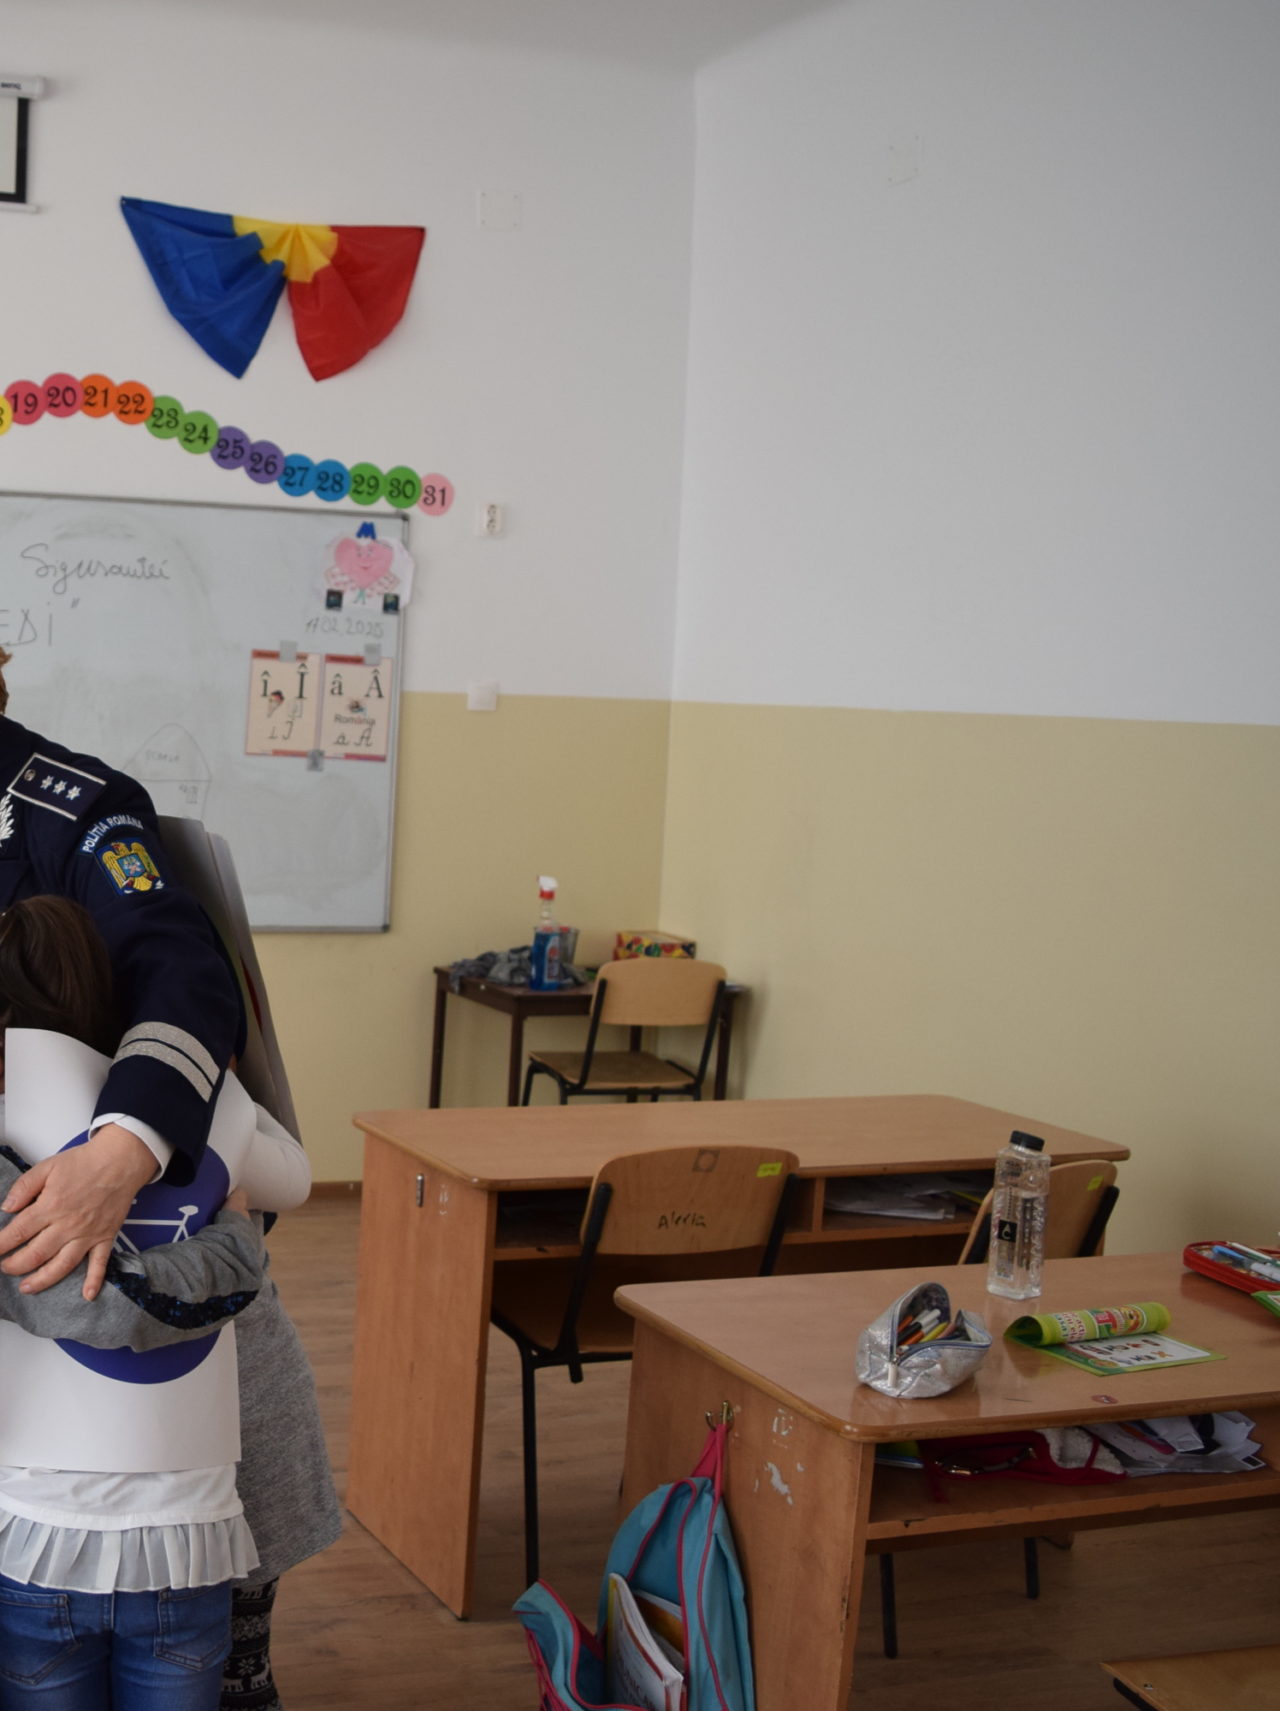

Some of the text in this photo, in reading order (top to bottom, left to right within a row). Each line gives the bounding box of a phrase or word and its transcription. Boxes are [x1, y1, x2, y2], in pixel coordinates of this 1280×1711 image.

[9, 392, 38, 414] 19
[48, 386, 76, 408] 20
[84, 386, 109, 408] 21
[118, 394, 146, 414] 22
[152, 408, 179, 429] 23
[184, 422, 210, 445] 24
[218, 438, 244, 461] 25
[250, 452, 277, 474] 26
[284, 466, 309, 487] 27
[318, 471, 344, 492] 28
[352, 475, 379, 496] 29
[389, 478, 416, 499] 30
[424, 486, 446, 506] 31
